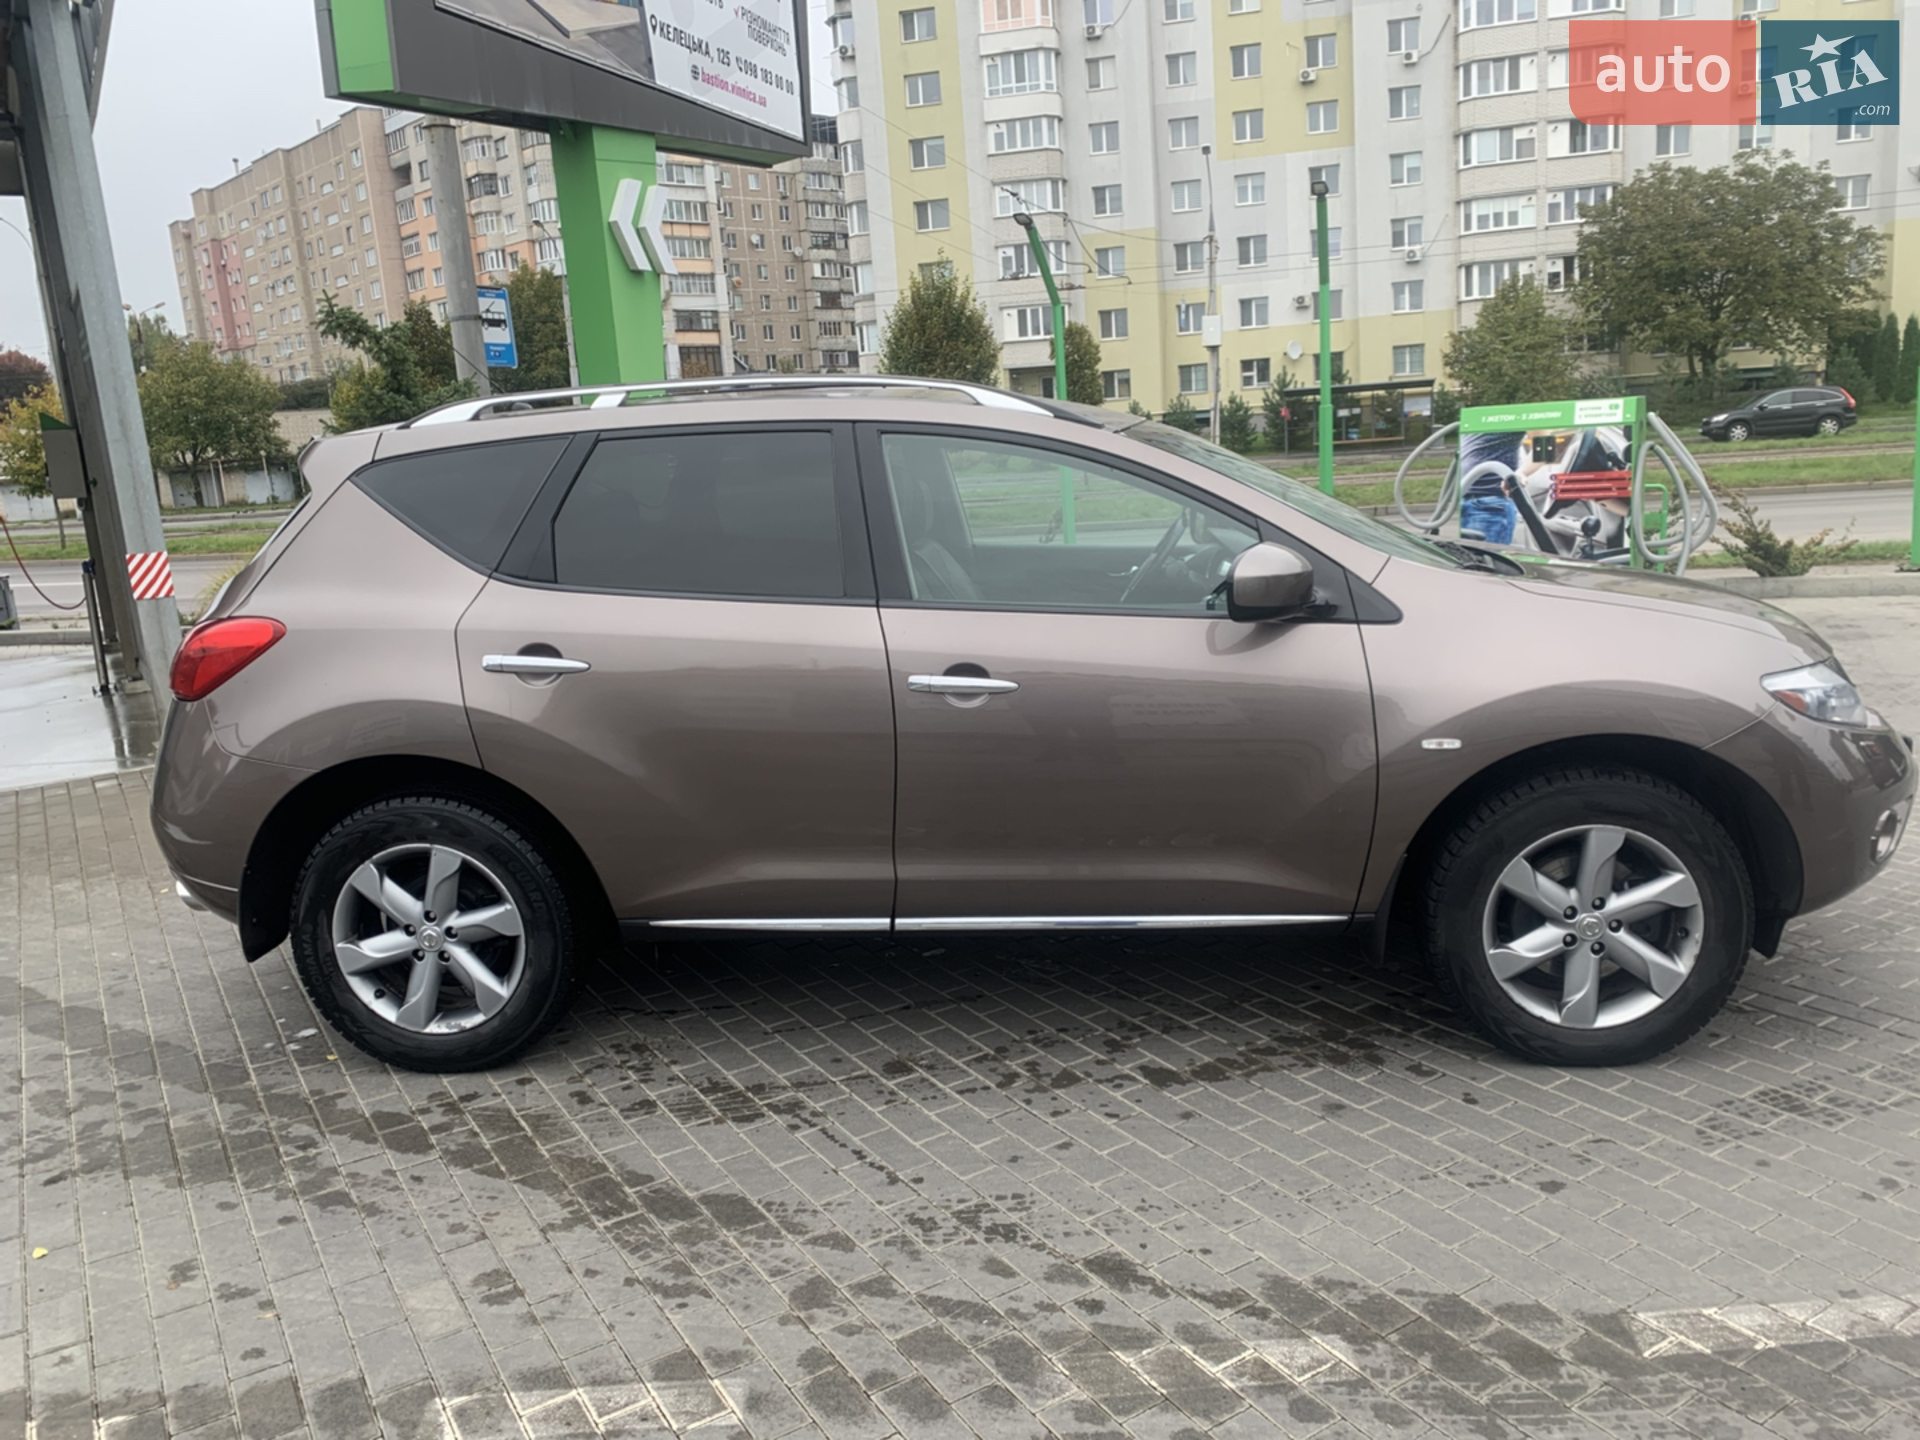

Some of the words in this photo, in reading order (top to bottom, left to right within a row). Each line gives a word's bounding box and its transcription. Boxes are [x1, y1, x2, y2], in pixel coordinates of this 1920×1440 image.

[741, 6, 790, 46] РІЗНОМАНІТТЯ
[747, 24, 787, 57] ПОВЕРХОНЬ
[659, 20, 714, 63] КЕЛЕЦЬКА,
[716, 47, 731, 67] 125
[743, 60, 758, 80] 098
[760, 67, 773, 86] 183
[775, 74, 784, 91] 00
[785, 78, 794, 96] 00
[701, 67, 767, 108] bastion.vinnica.ua
